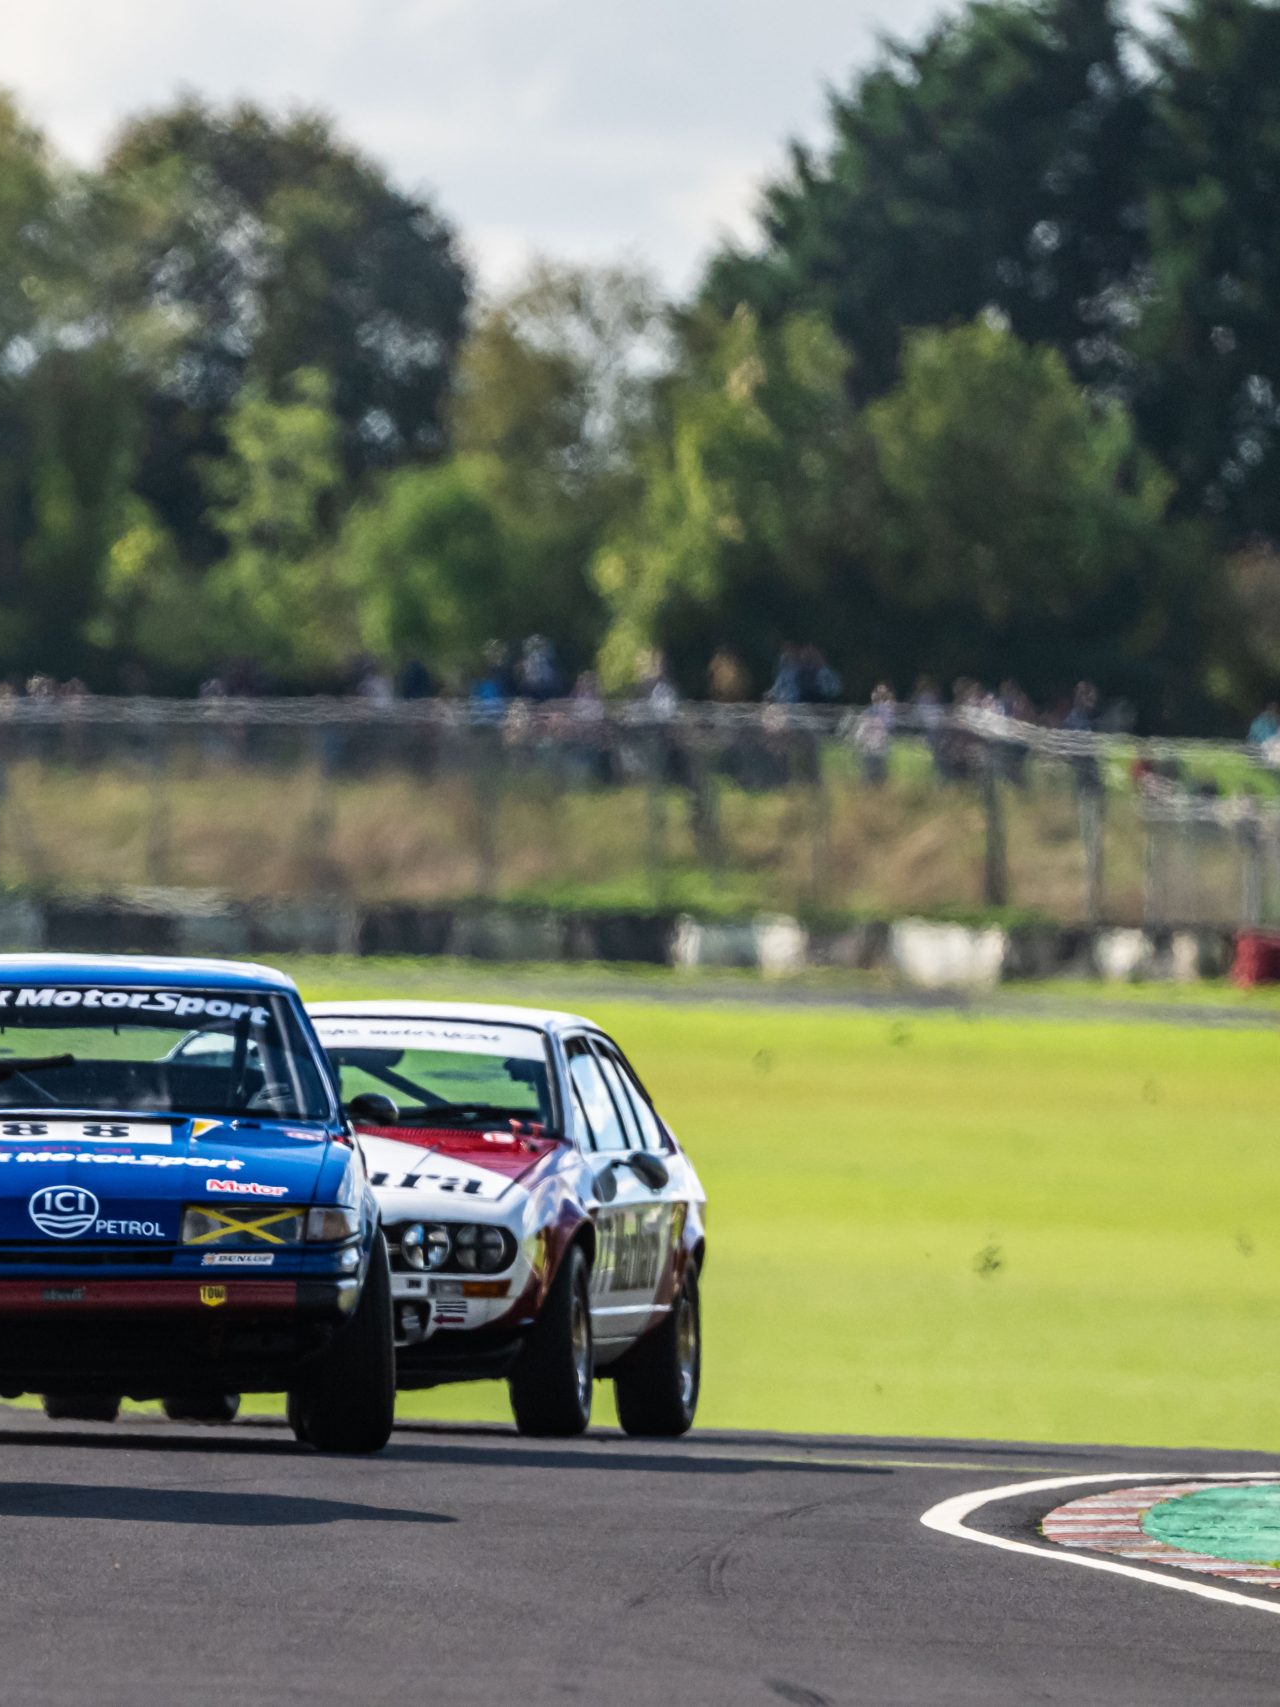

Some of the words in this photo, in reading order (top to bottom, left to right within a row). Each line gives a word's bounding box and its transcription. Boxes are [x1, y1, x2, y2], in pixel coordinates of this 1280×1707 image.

[208, 1180, 287, 1195] Motor
[44, 1192, 85, 1212] ICI
[95, 1220, 166, 1237] PETROL
